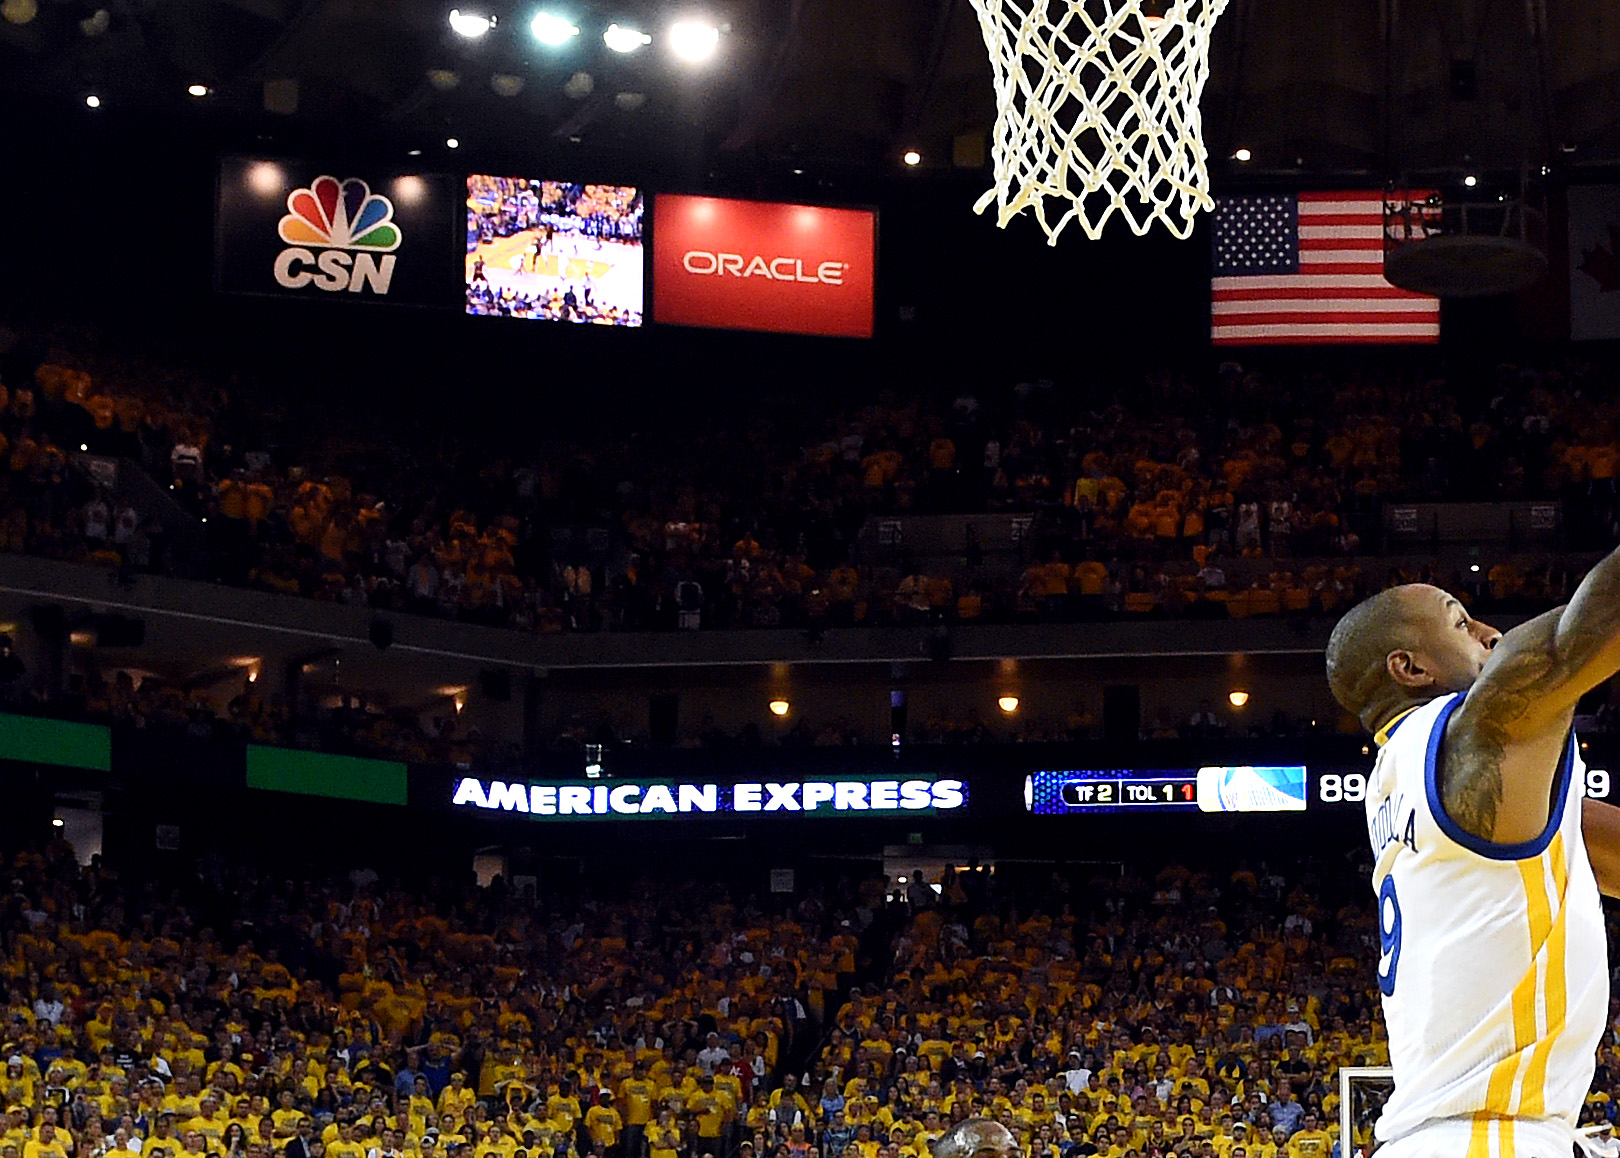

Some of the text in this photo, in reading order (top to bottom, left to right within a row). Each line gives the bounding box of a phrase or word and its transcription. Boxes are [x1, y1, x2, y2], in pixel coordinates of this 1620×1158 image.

[273, 248, 397, 295] CSN
[683, 249, 845, 286] ORACLE
[453, 777, 964, 815] AMERICAN EXPRESS
[1075, 784, 1112, 802] TF 2
[1126, 783, 1194, 801] TOL 1 1
[1319, 774, 1366, 802] 89
[1579, 770, 1610, 798] 9
[1377, 873, 1403, 998] 9
